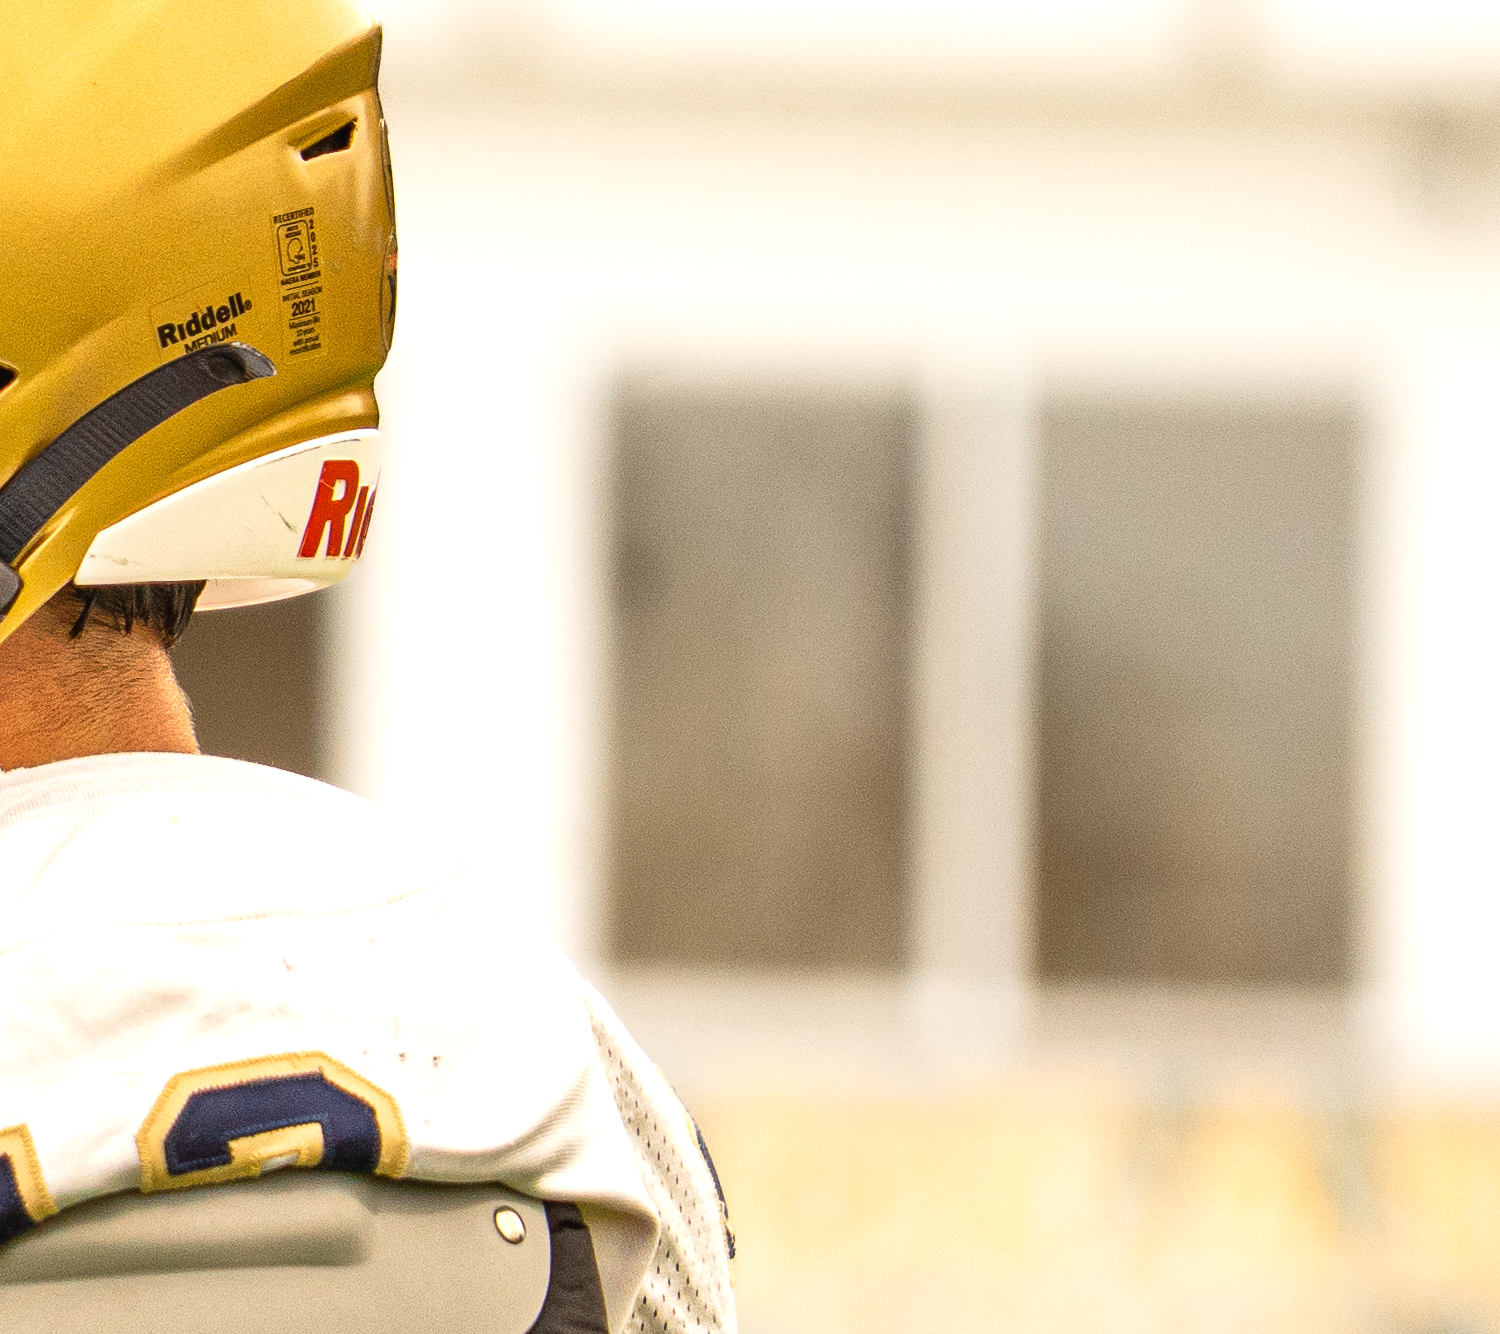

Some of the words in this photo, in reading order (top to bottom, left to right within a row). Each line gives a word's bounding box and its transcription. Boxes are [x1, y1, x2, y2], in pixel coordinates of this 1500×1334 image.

[273, 207, 315, 224] RECERTIFIED
[291, 298, 316, 317] 2021
[184, 323, 238, 354] MEDIUM
